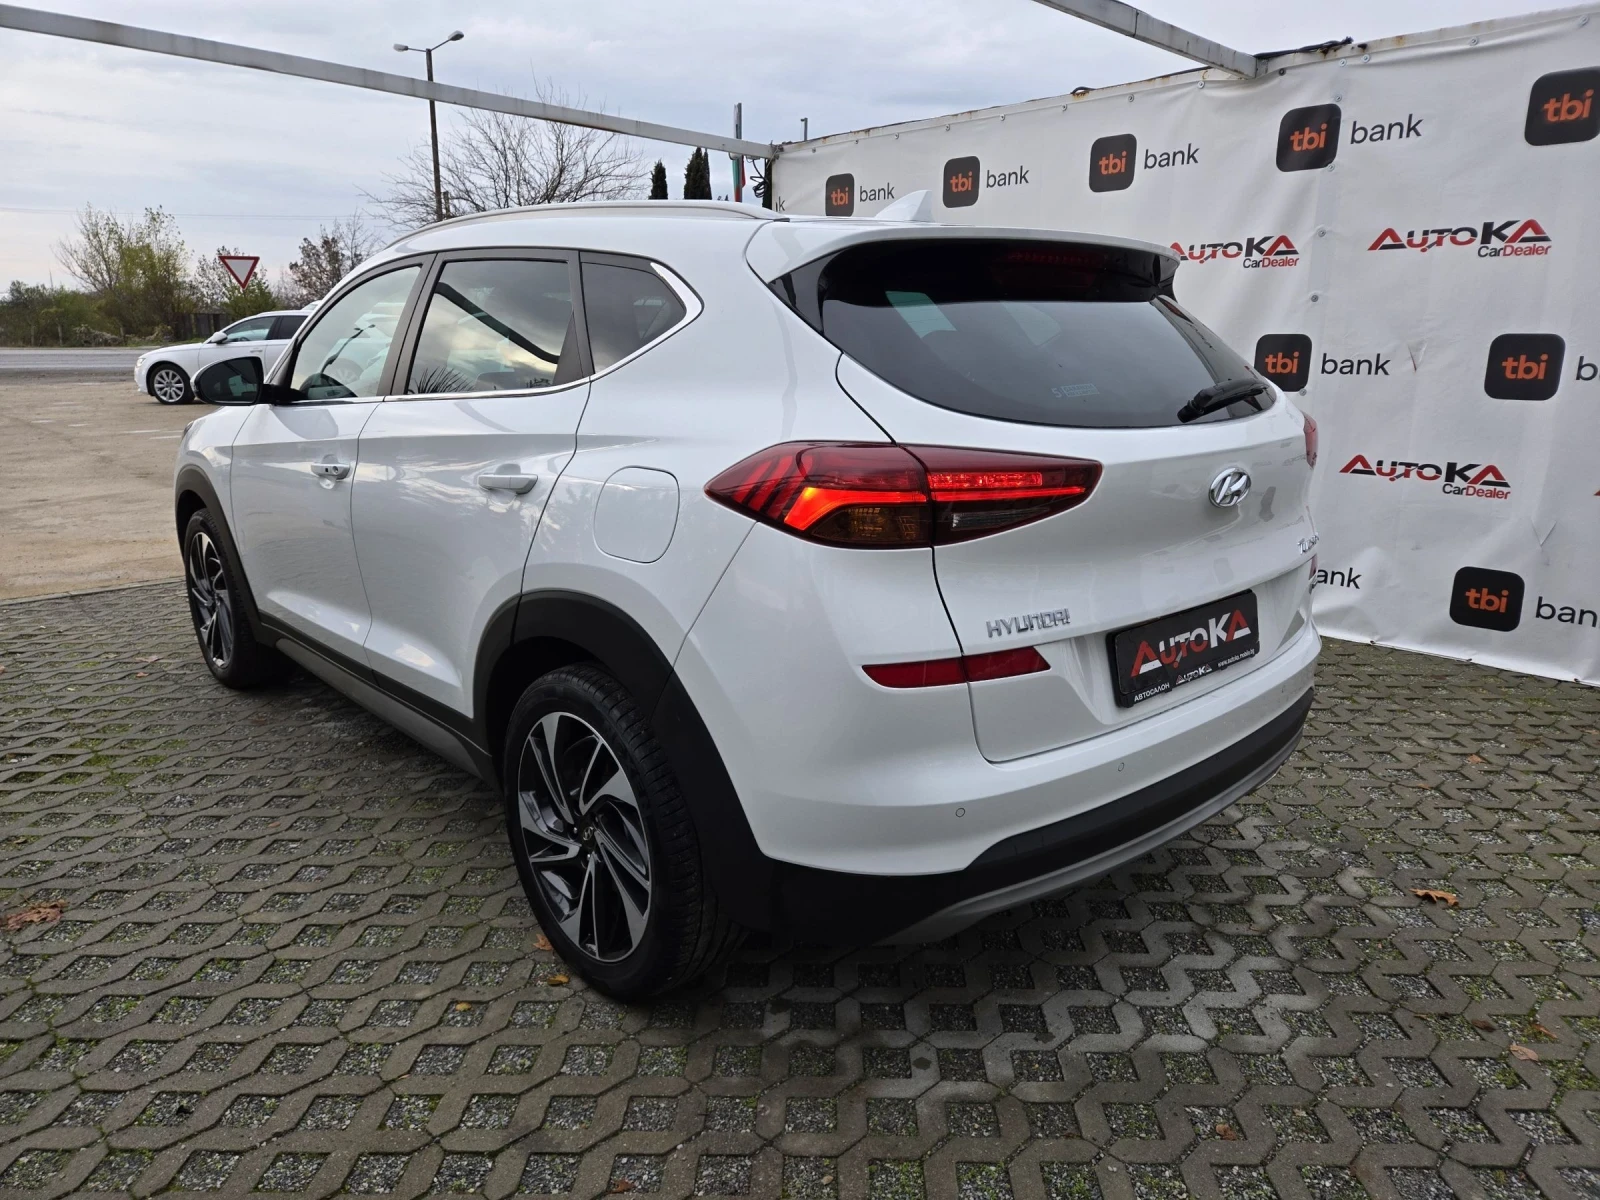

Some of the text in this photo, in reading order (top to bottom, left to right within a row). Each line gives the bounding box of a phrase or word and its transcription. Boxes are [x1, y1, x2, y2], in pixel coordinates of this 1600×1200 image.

[1543, 89, 1594, 123] tbi
[1290, 114, 1424, 151] tbi bank
[1099, 143, 1200, 175] tbi bank
[950, 165, 1029, 193] tbi bank
[831, 182, 895, 206] tbi bank
[1265, 351, 1390, 376] tbi bank
[1502, 354, 1549, 380] tbi
[1316, 567, 1362, 590] ank
[1465, 588, 1600, 628] tbi ban
[986, 608, 1071, 639] HYUNDAI
